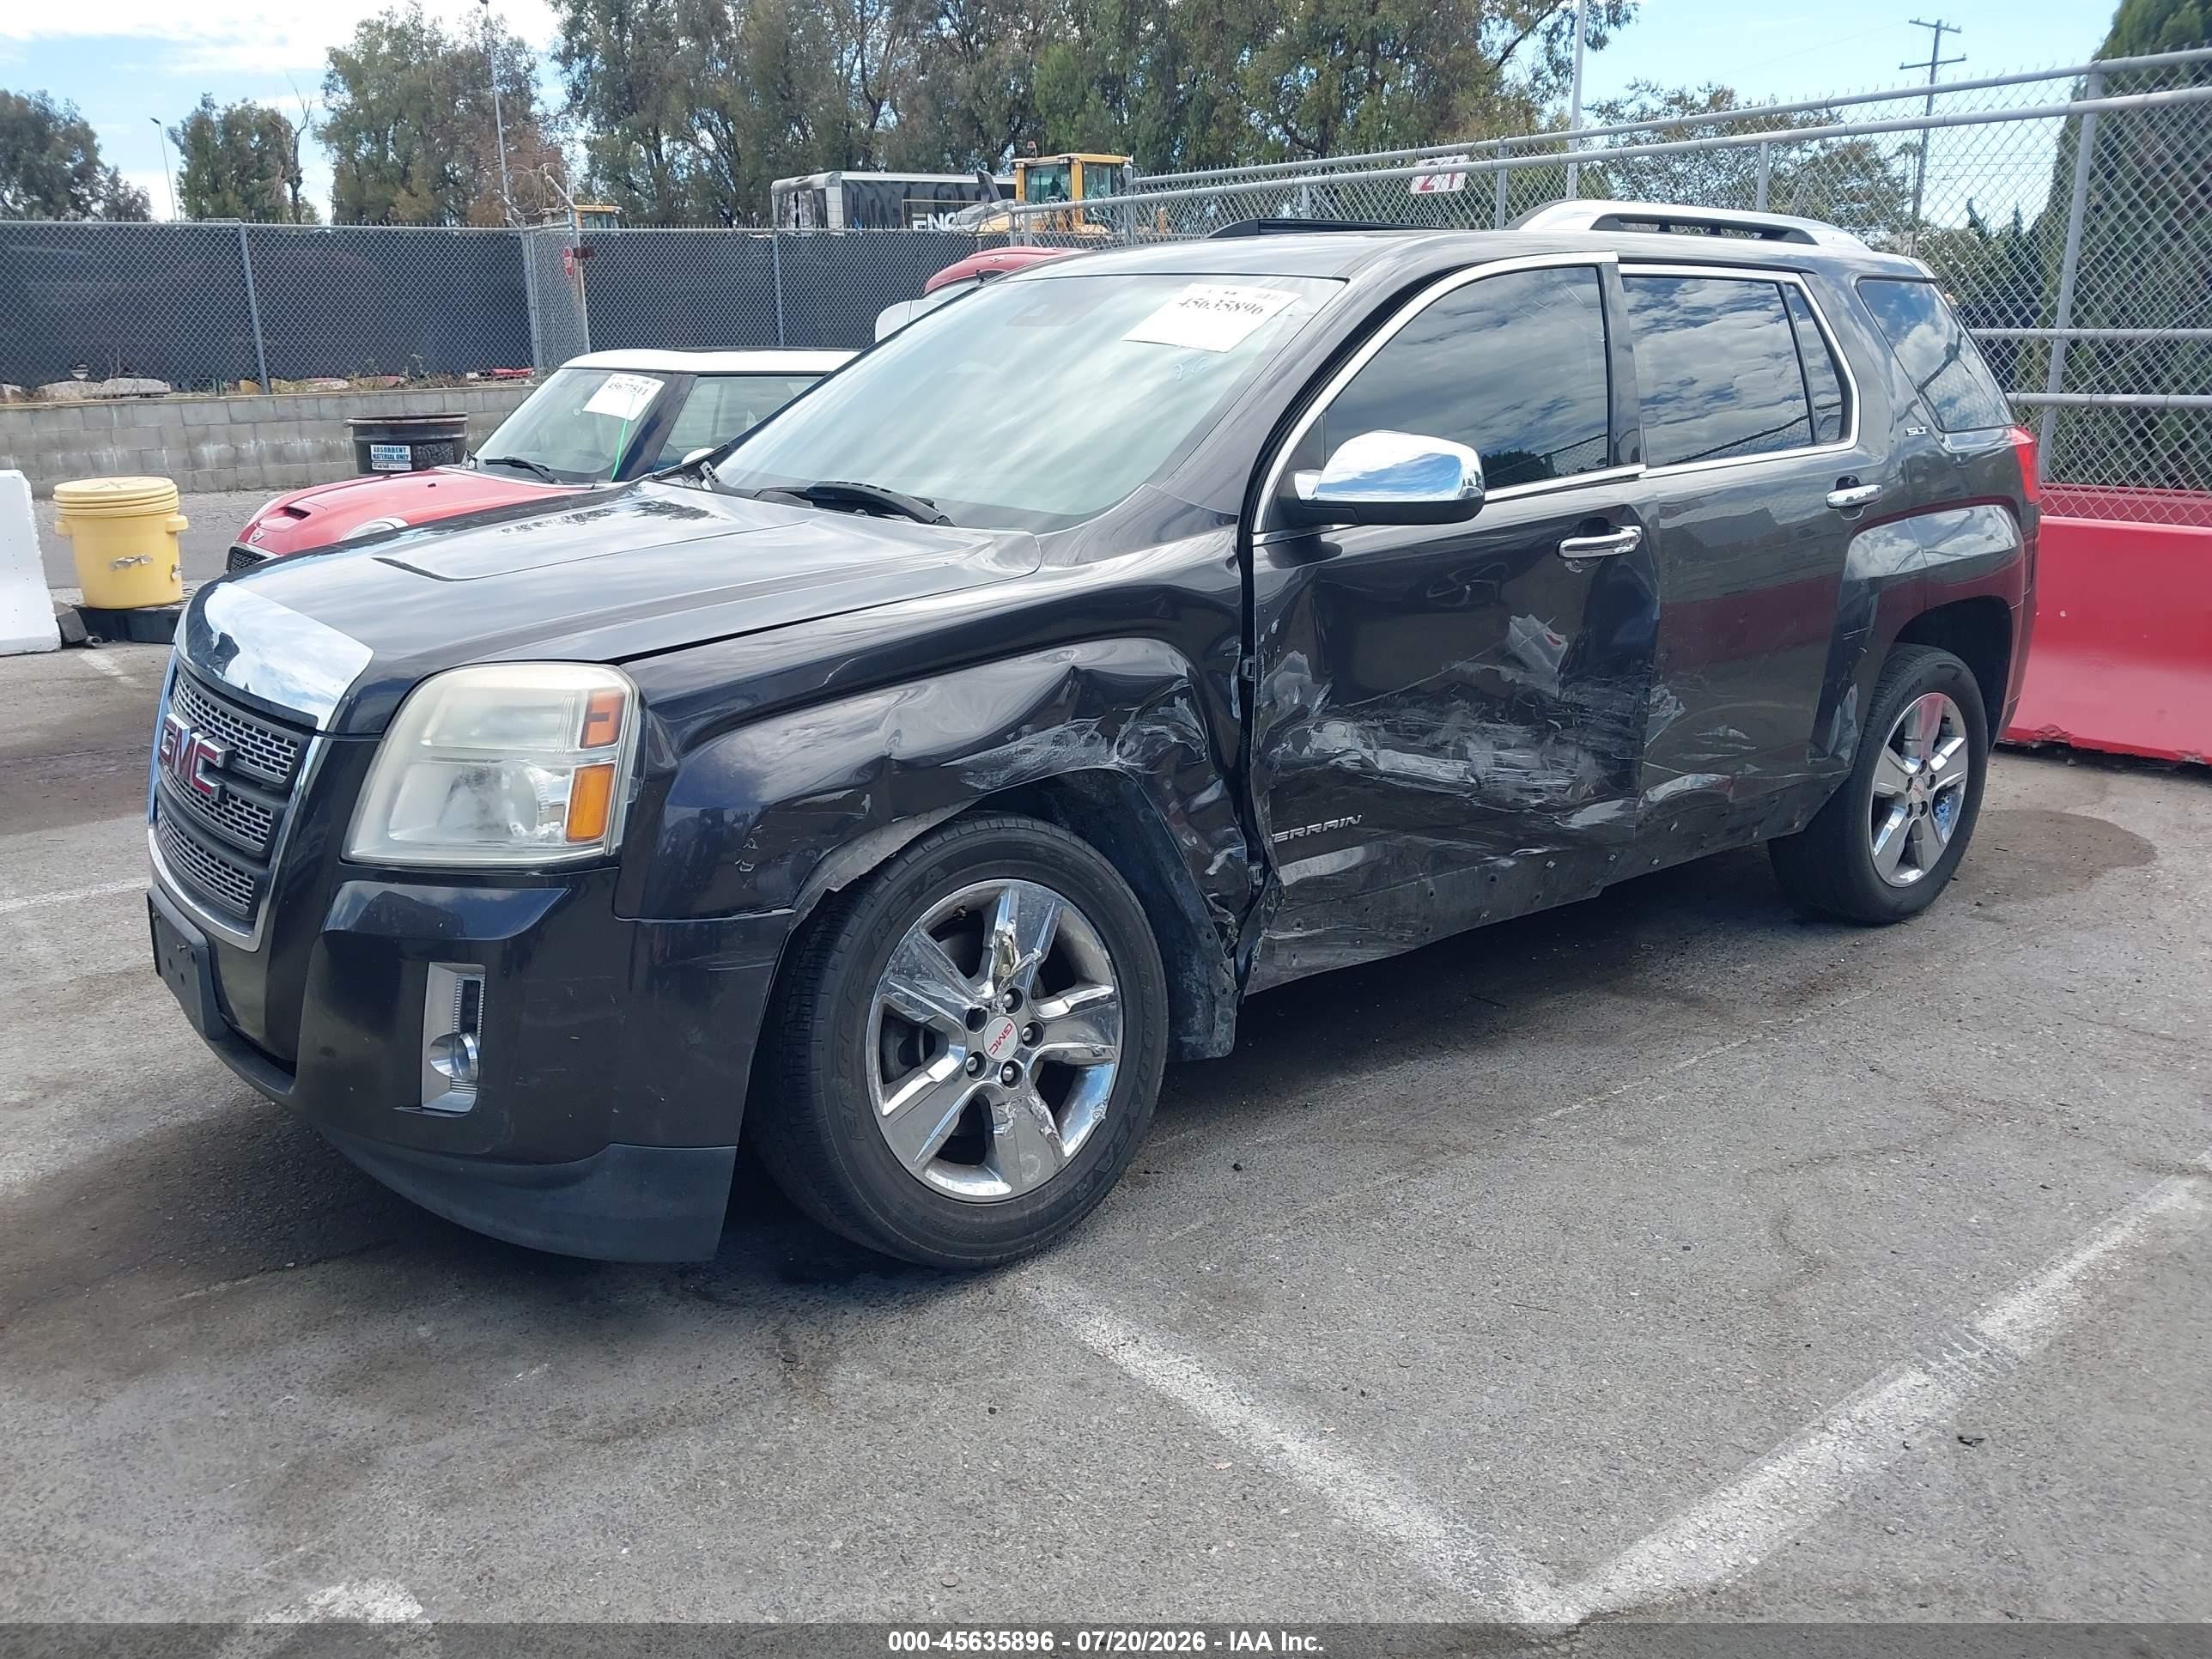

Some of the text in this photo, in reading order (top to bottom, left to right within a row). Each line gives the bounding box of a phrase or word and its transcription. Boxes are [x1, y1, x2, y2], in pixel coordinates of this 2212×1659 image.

[1177, 298, 1264, 315] 45635896
[1906, 426, 1928, 436] SLT
[159, 713, 226, 802] GMC
[1272, 814, 1362, 843] ERRAIN
[988, 1023, 1013, 1055] GMC
